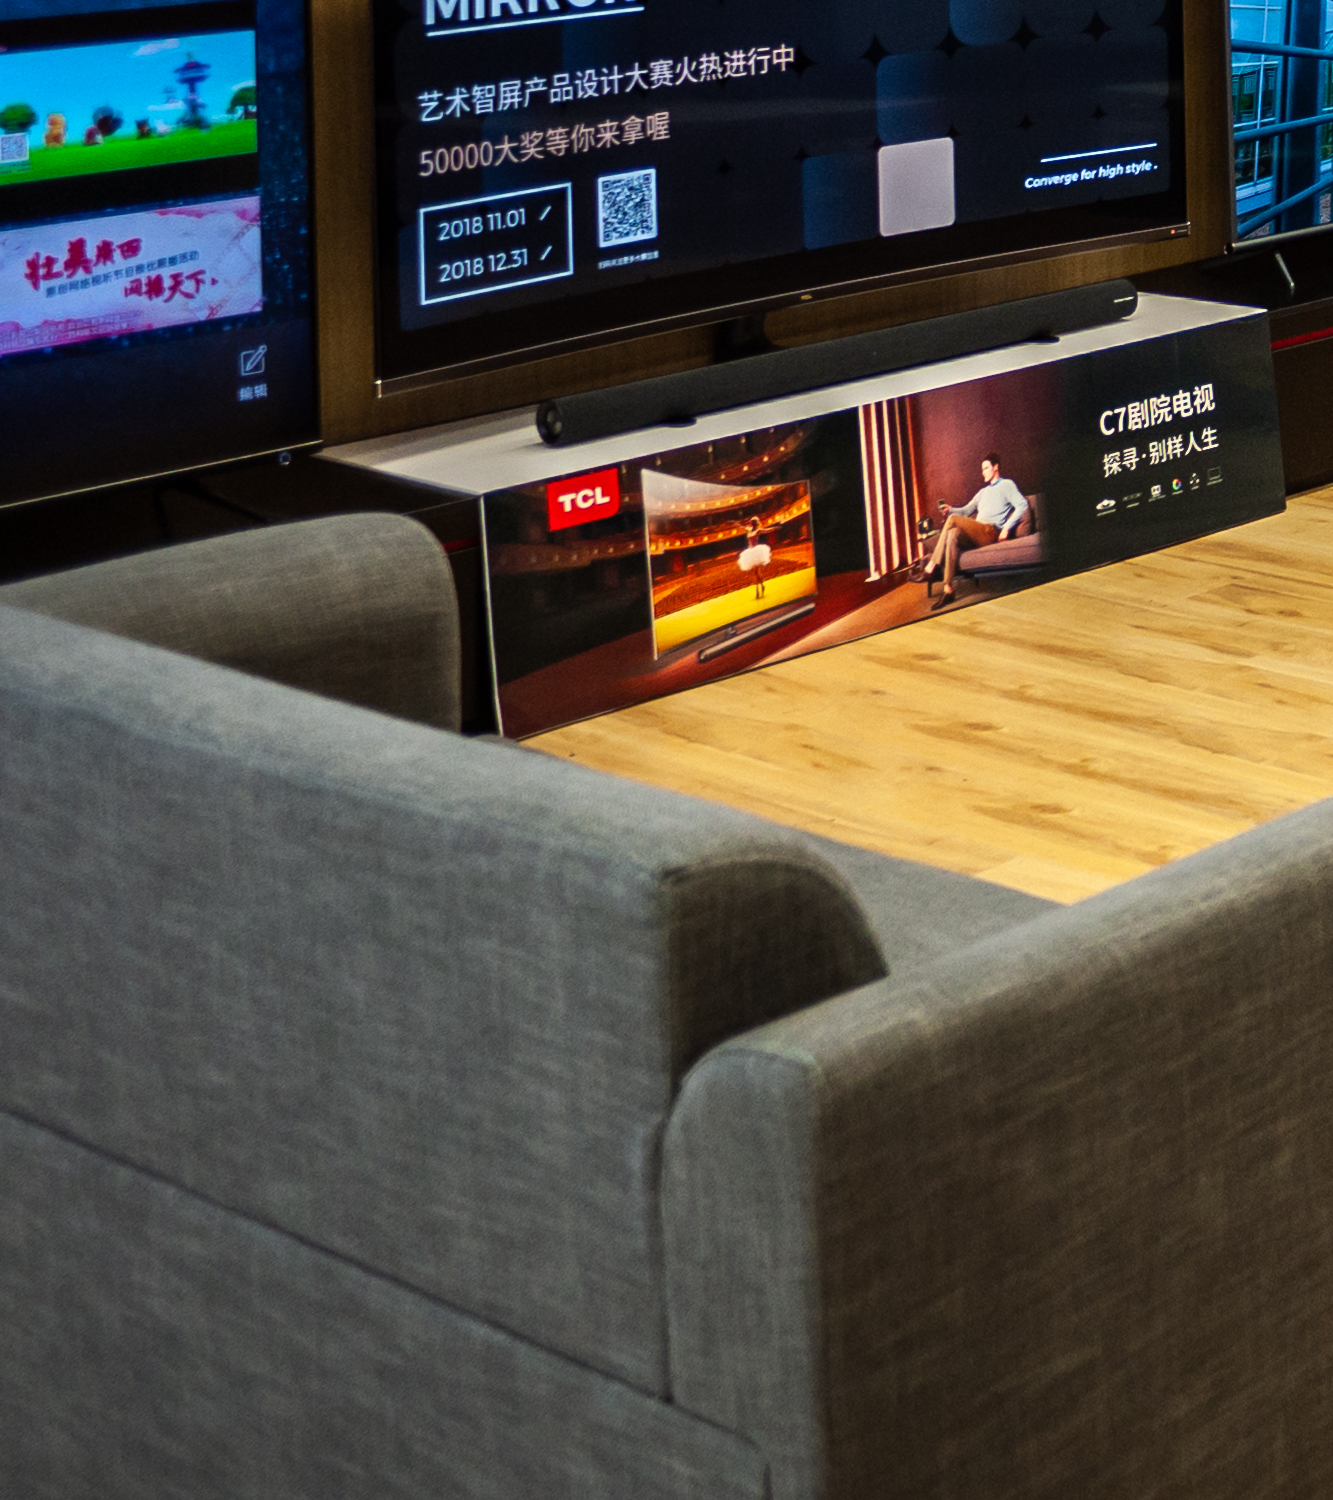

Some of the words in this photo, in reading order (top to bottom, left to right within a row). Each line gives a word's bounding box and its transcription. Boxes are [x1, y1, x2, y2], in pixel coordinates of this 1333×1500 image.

[417, 44, 794, 123] 艺术智屏产品设计大赛火热进行中
[418, 112, 670, 176] 50000大奖等你来拿喔
[1024, 171, 1079, 189] Converge
[1080, 169, 1096, 184] for
[1098, 164, 1124, 180] high
[1125, 160, 1152, 175] style
[438, 216, 483, 241] 2018
[487, 208, 526, 231] 11.01
[439, 256, 484, 282] 2018
[487, 249, 528, 272] 12.31
[1100, 383, 1216, 436] C7剧院电视
[1103, 427, 1219, 478] 探寻·别样人生
[557, 486, 611, 513] TCL
